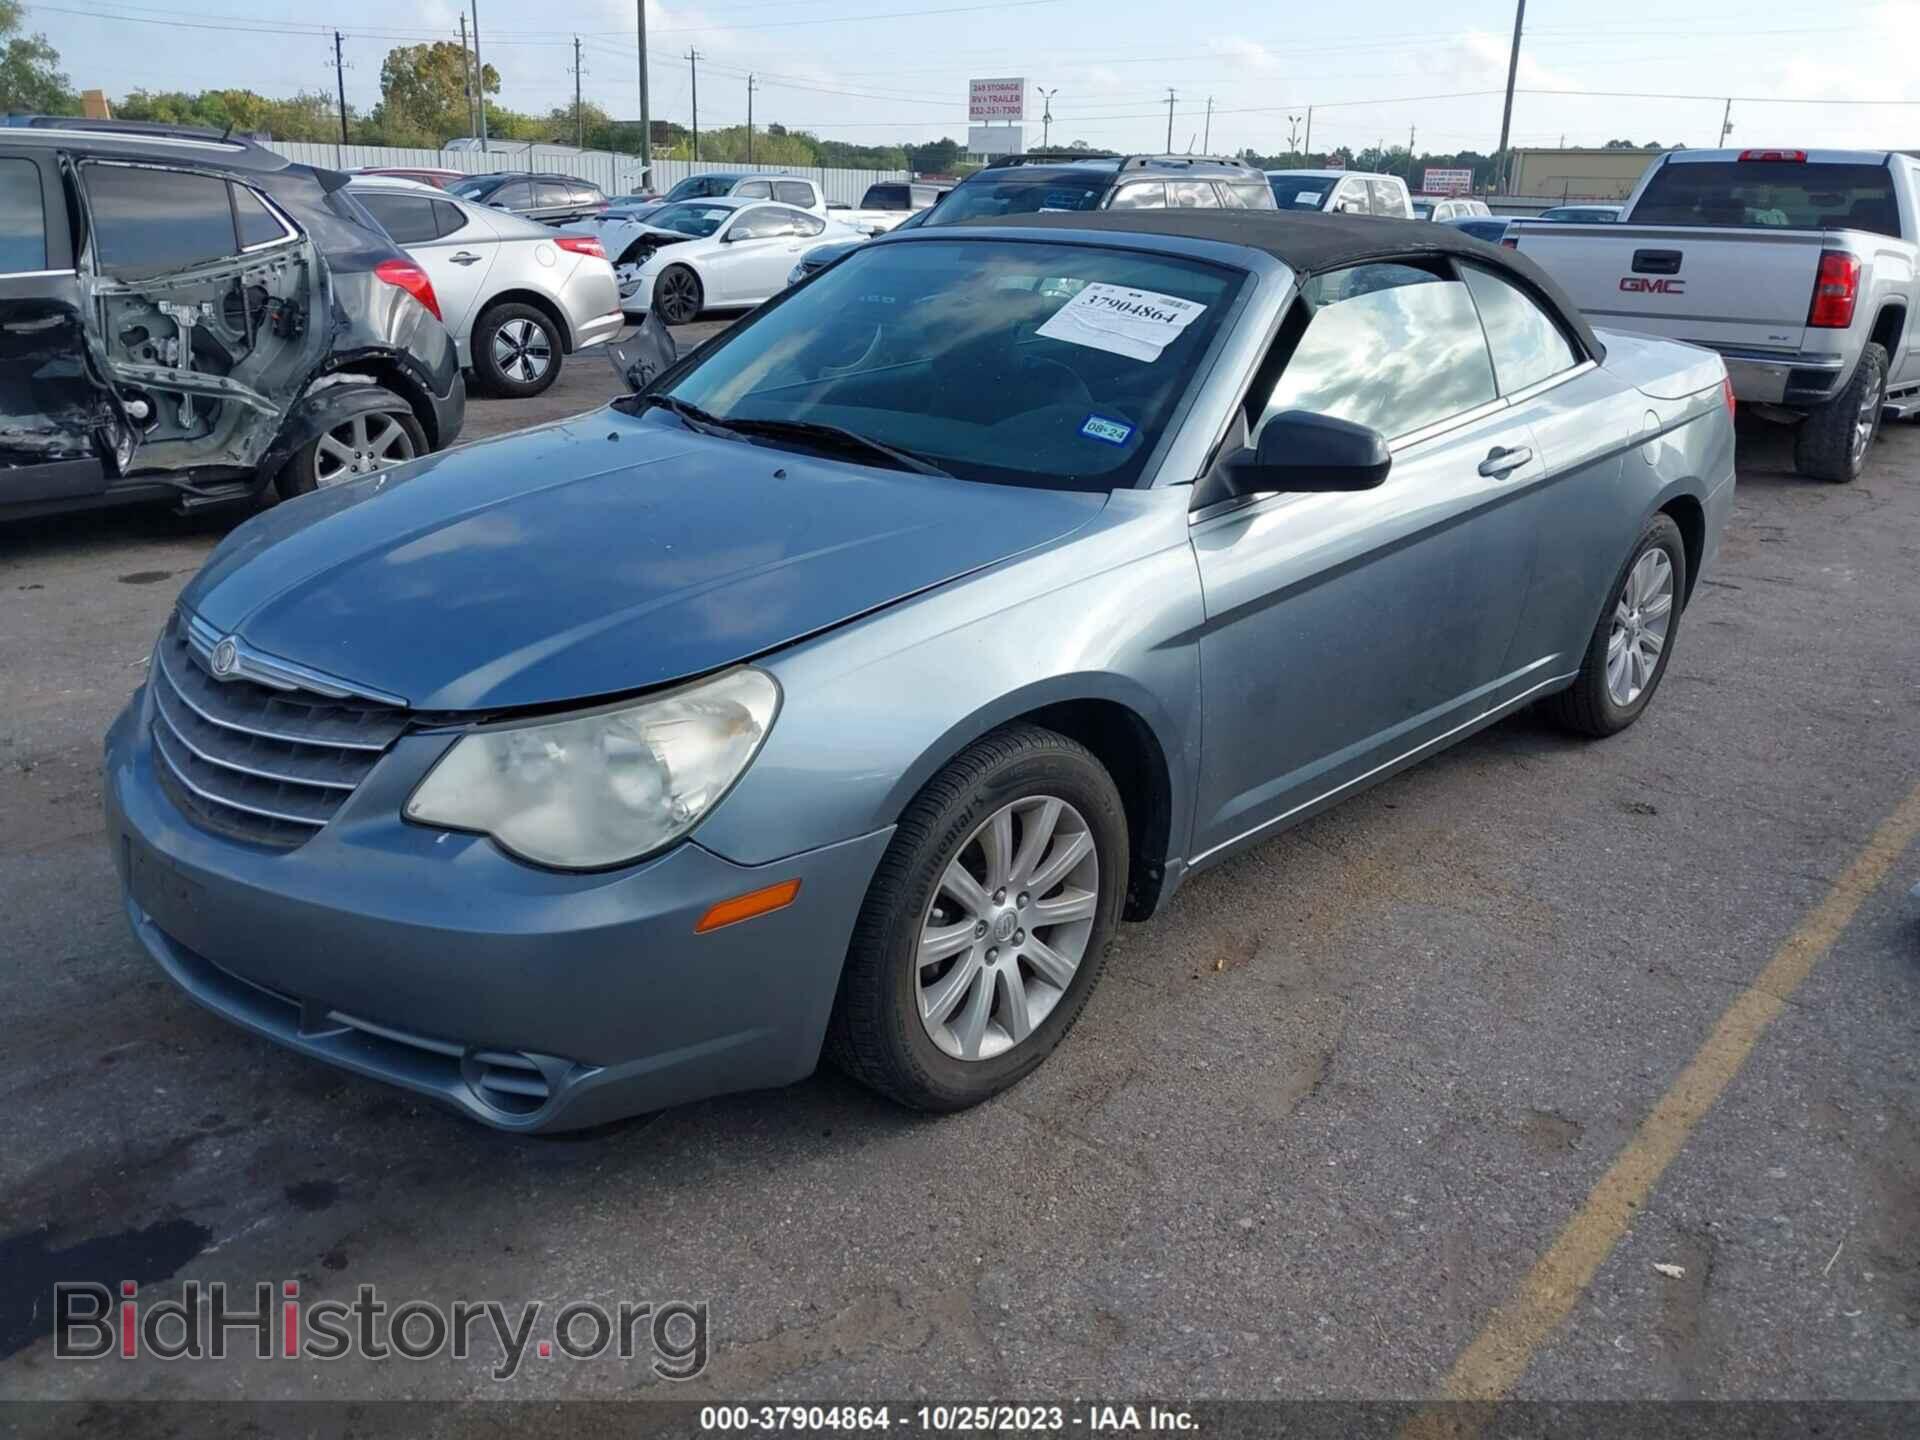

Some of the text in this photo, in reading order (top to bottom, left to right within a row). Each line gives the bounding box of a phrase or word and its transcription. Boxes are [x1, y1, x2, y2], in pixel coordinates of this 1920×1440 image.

[987, 83, 1019, 91] STORAGE
[971, 95, 982, 103] RV
[988, 95, 1020, 103] TRAILER
[1620, 277, 1686, 294] GMC
[1082, 295, 1178, 323] 37904864
